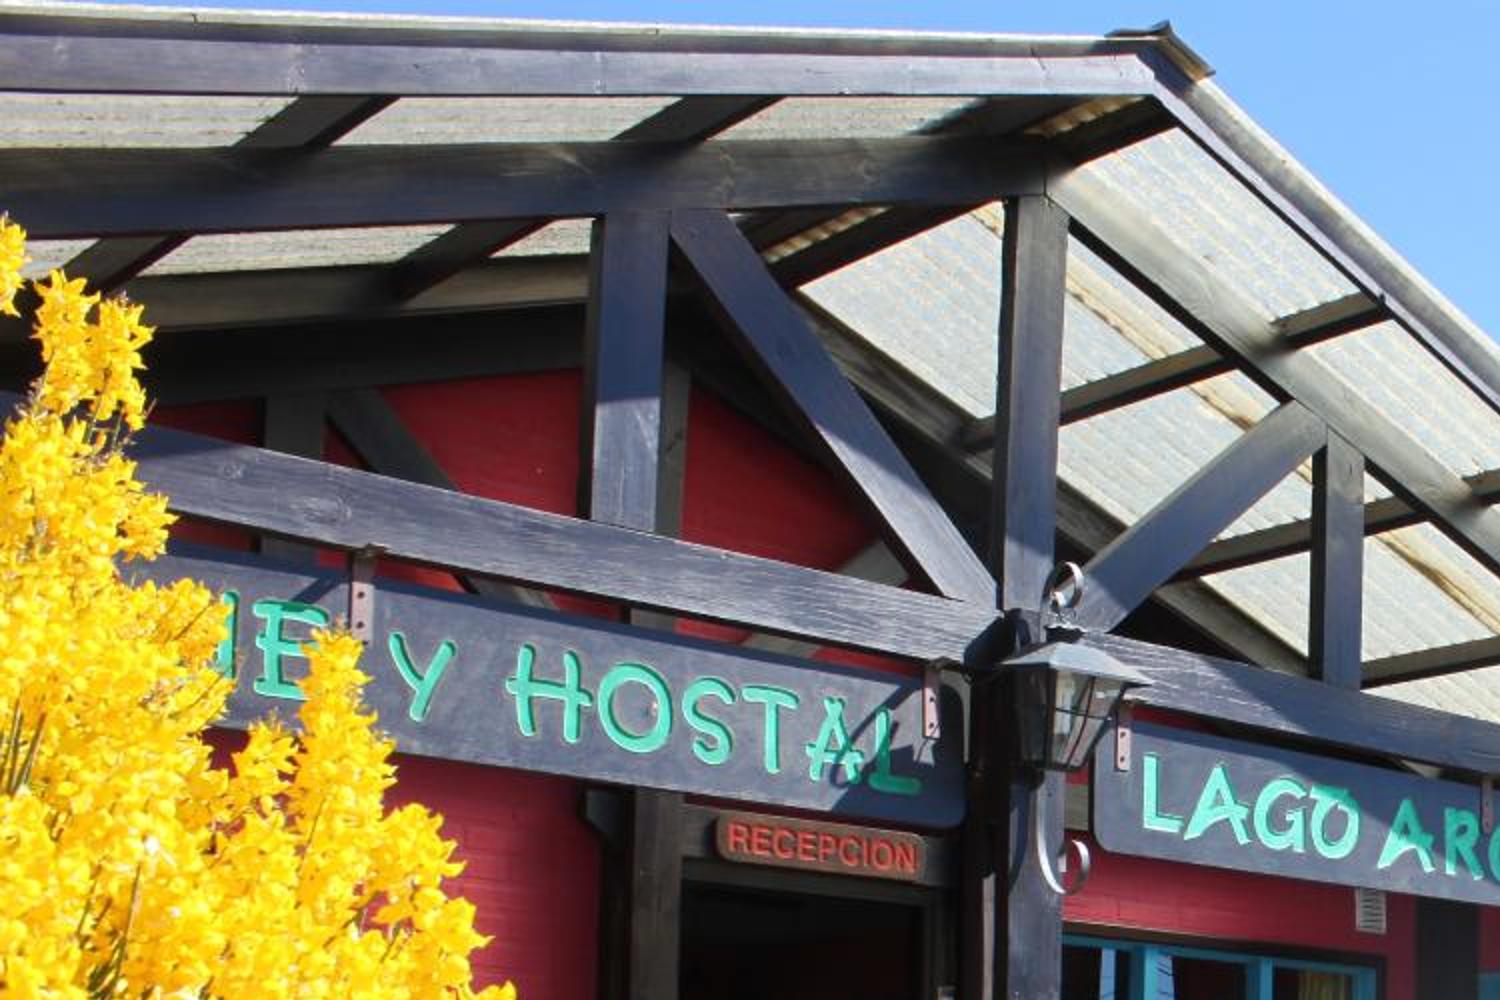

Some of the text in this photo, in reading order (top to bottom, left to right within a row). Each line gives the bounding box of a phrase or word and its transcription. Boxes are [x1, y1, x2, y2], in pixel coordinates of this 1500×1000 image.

[388, 630, 458, 722] Y
[505, 642, 922, 797] HOSTAL
[728, 820, 918, 874] RECEPCION
[1142, 752, 1364, 860] LAGO
